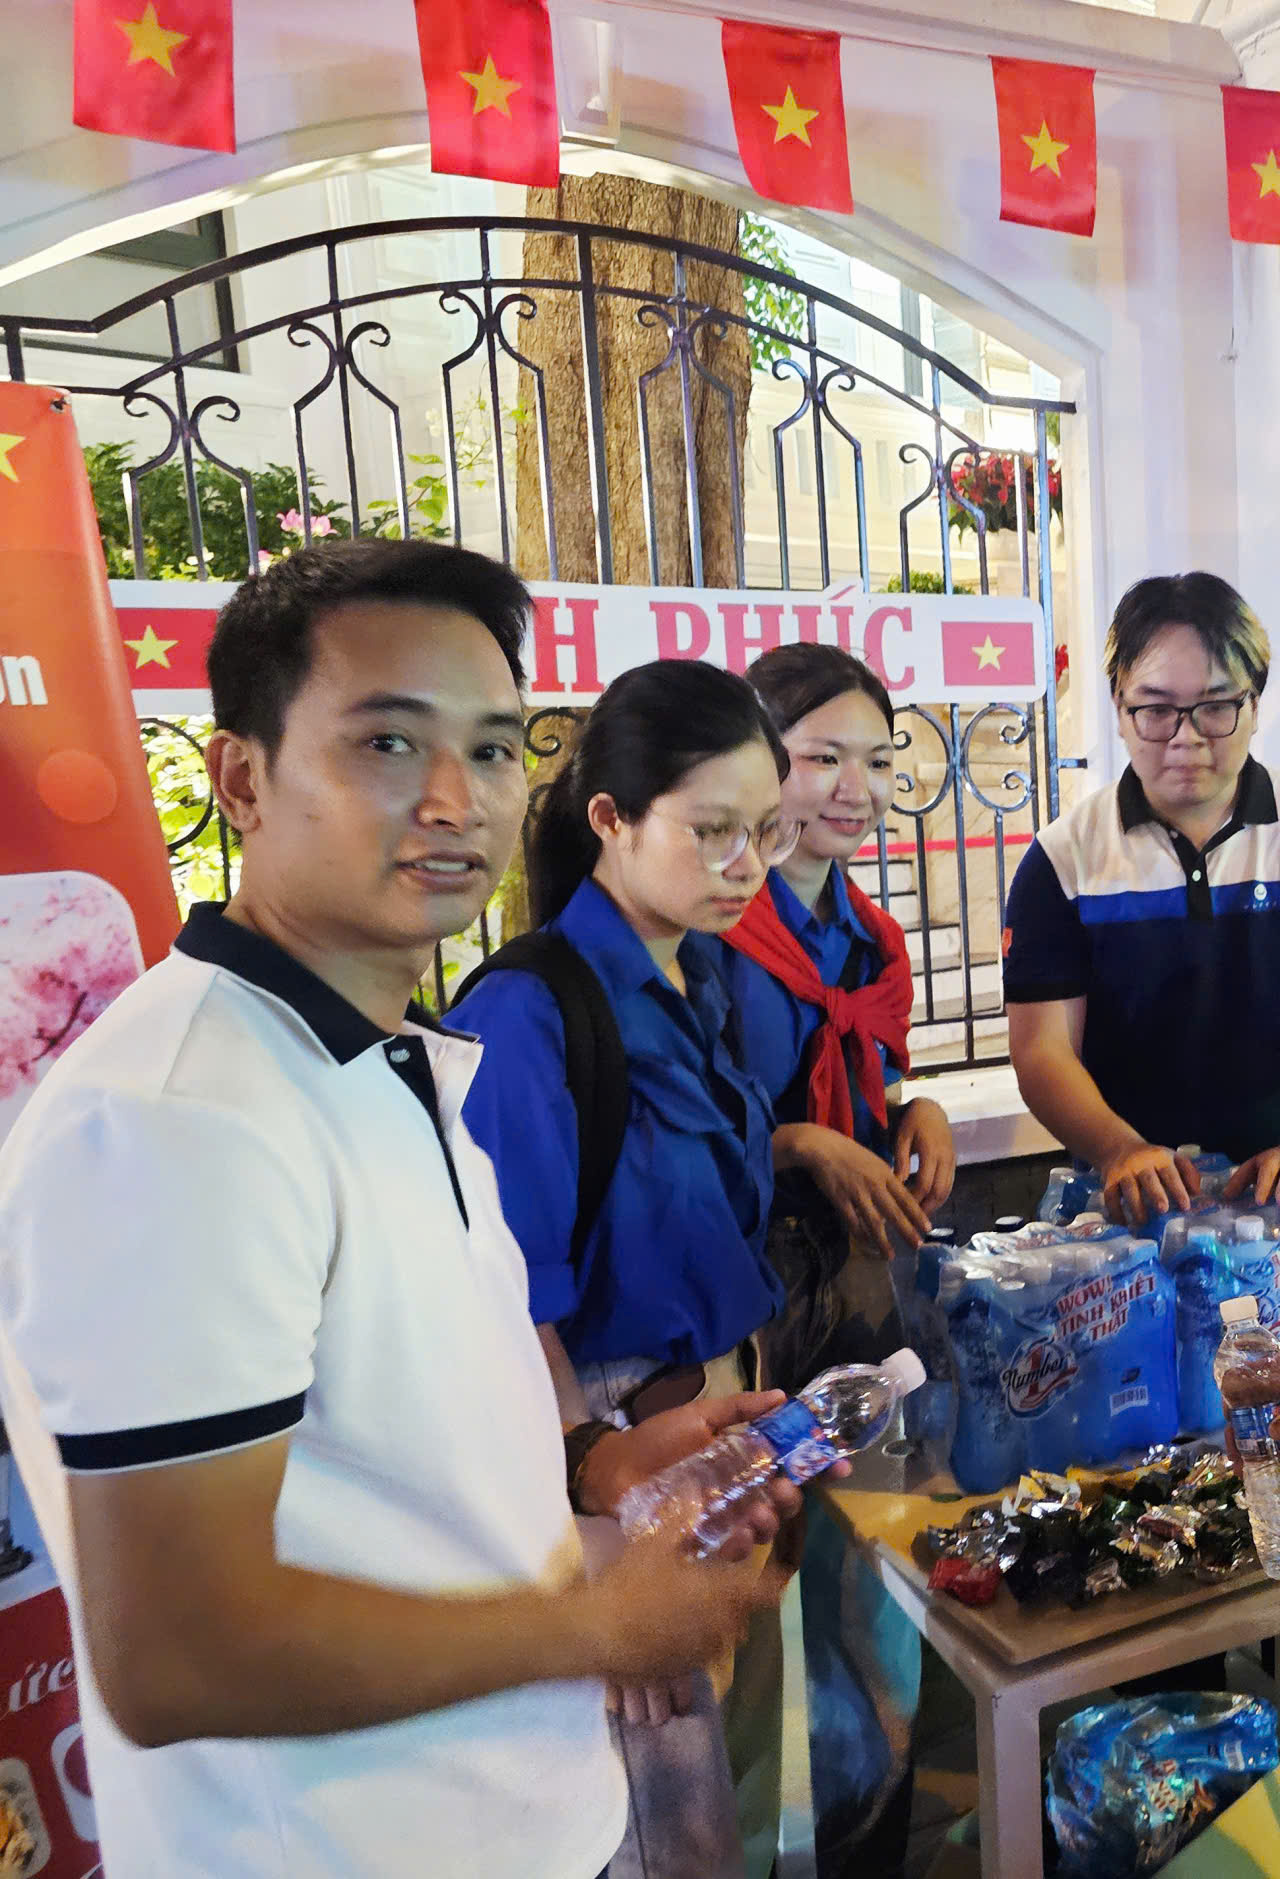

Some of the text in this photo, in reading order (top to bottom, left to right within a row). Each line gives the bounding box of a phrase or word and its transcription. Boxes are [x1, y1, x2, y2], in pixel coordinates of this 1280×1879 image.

[1057, 1276, 1113, 1314] WOW!
[1110, 1272, 1155, 1313] KHIẾT
[1002, 1352, 1071, 1391] Number
